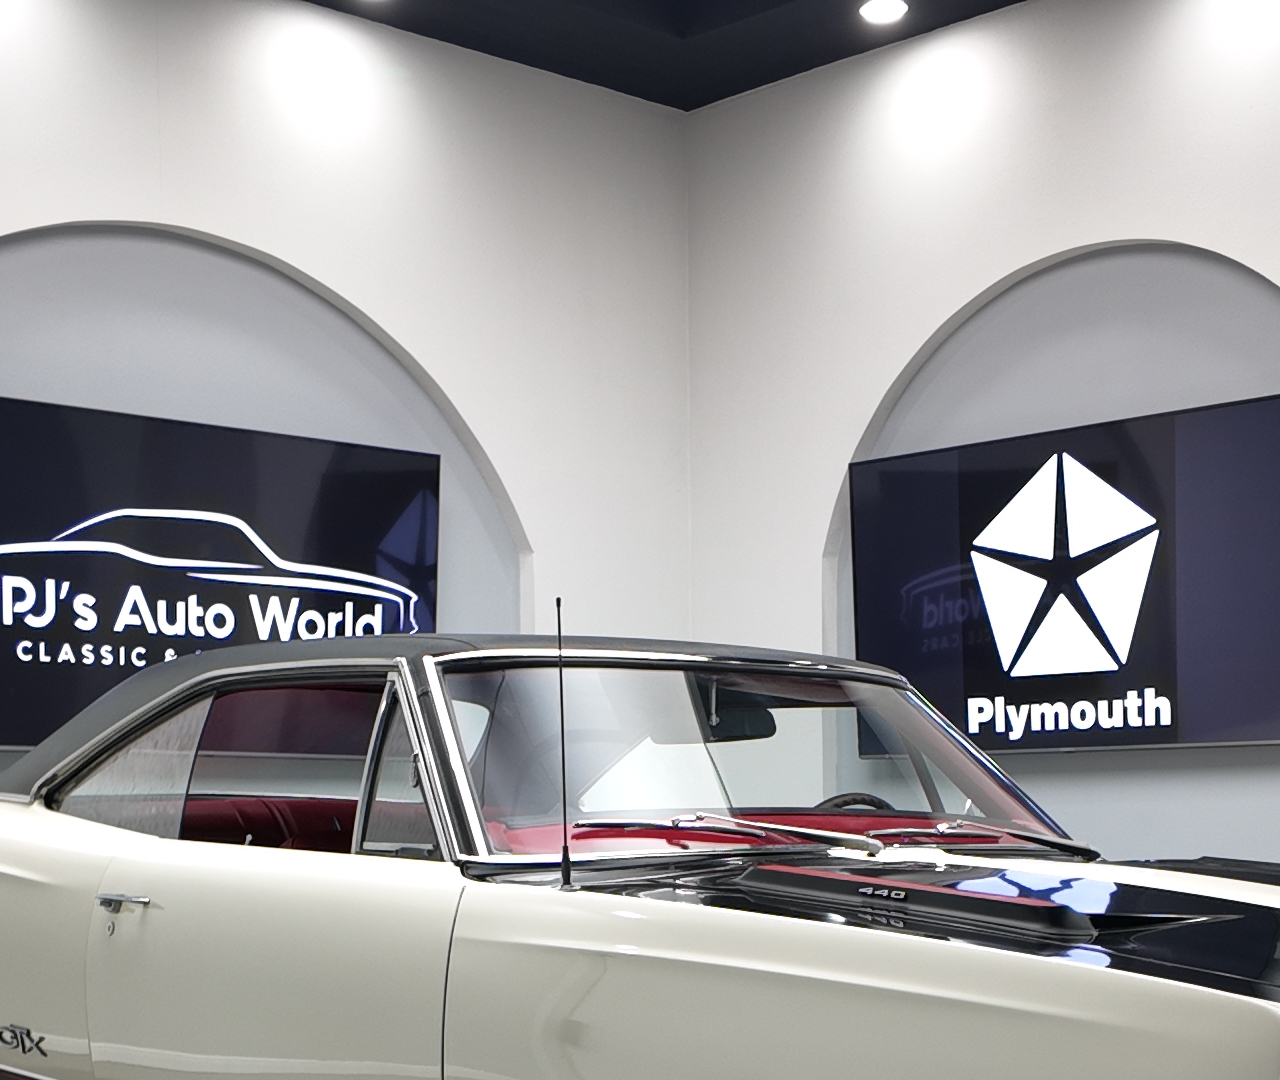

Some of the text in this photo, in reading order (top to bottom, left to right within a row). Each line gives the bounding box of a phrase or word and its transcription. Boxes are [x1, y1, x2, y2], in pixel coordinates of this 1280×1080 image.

[1, 575, 383, 642] PJ's Auto World
[16, 640, 147, 667] CLASSIC
[967, 687, 1172, 741] Plymouth
[858, 886, 906, 899] 440
